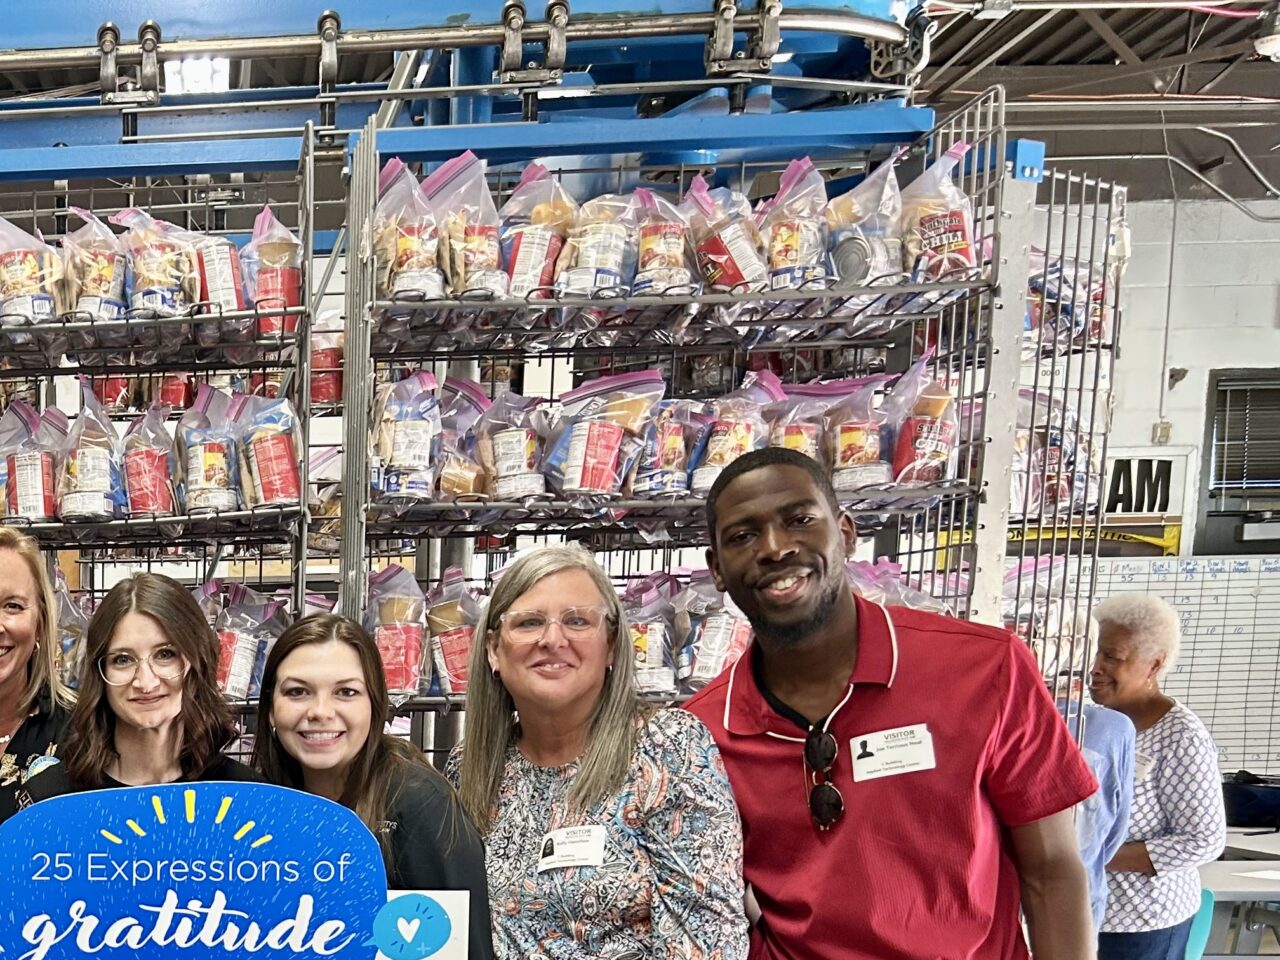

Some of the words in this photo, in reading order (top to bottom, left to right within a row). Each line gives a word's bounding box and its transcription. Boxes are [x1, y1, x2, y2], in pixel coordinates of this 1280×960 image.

[884, 729, 915, 740] VISITOR
[31, 852, 73, 881] 25
[87, 852, 300, 886] Expressions
[313, 852, 352, 882] of
